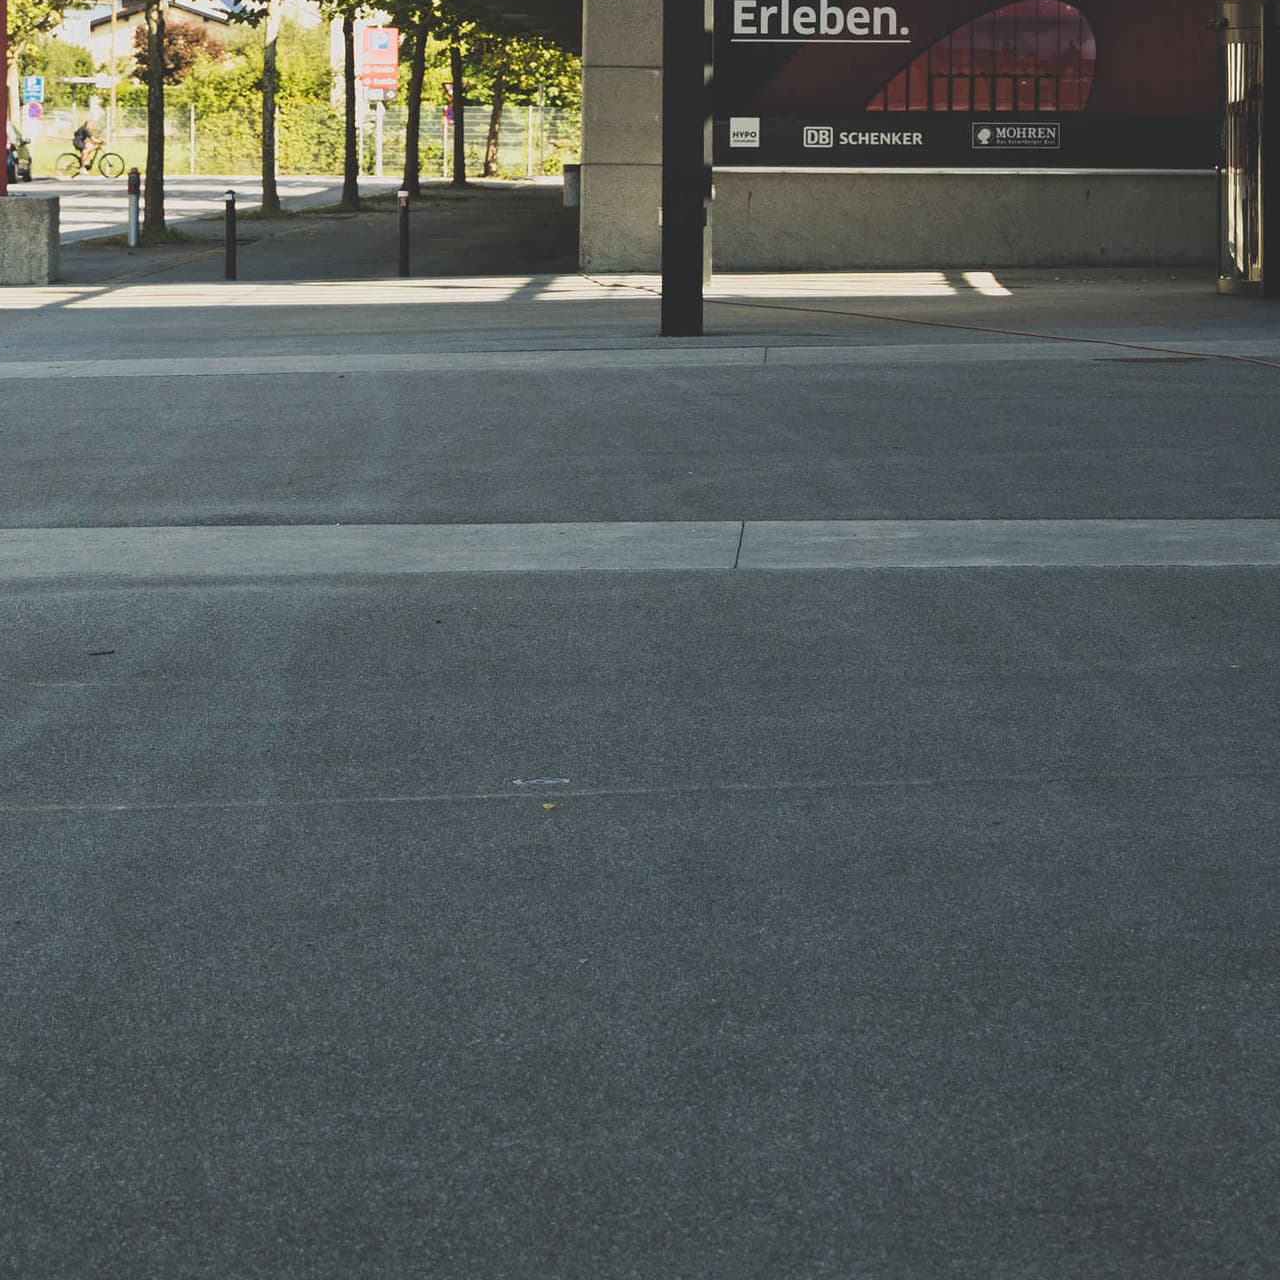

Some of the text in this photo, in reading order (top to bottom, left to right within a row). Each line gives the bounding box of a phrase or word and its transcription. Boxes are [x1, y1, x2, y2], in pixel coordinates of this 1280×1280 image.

[732, 130, 757, 139] HYPO
[807, 130, 923, 145] DB SCHENKER
[995, 127, 1057, 139] MOHREN
